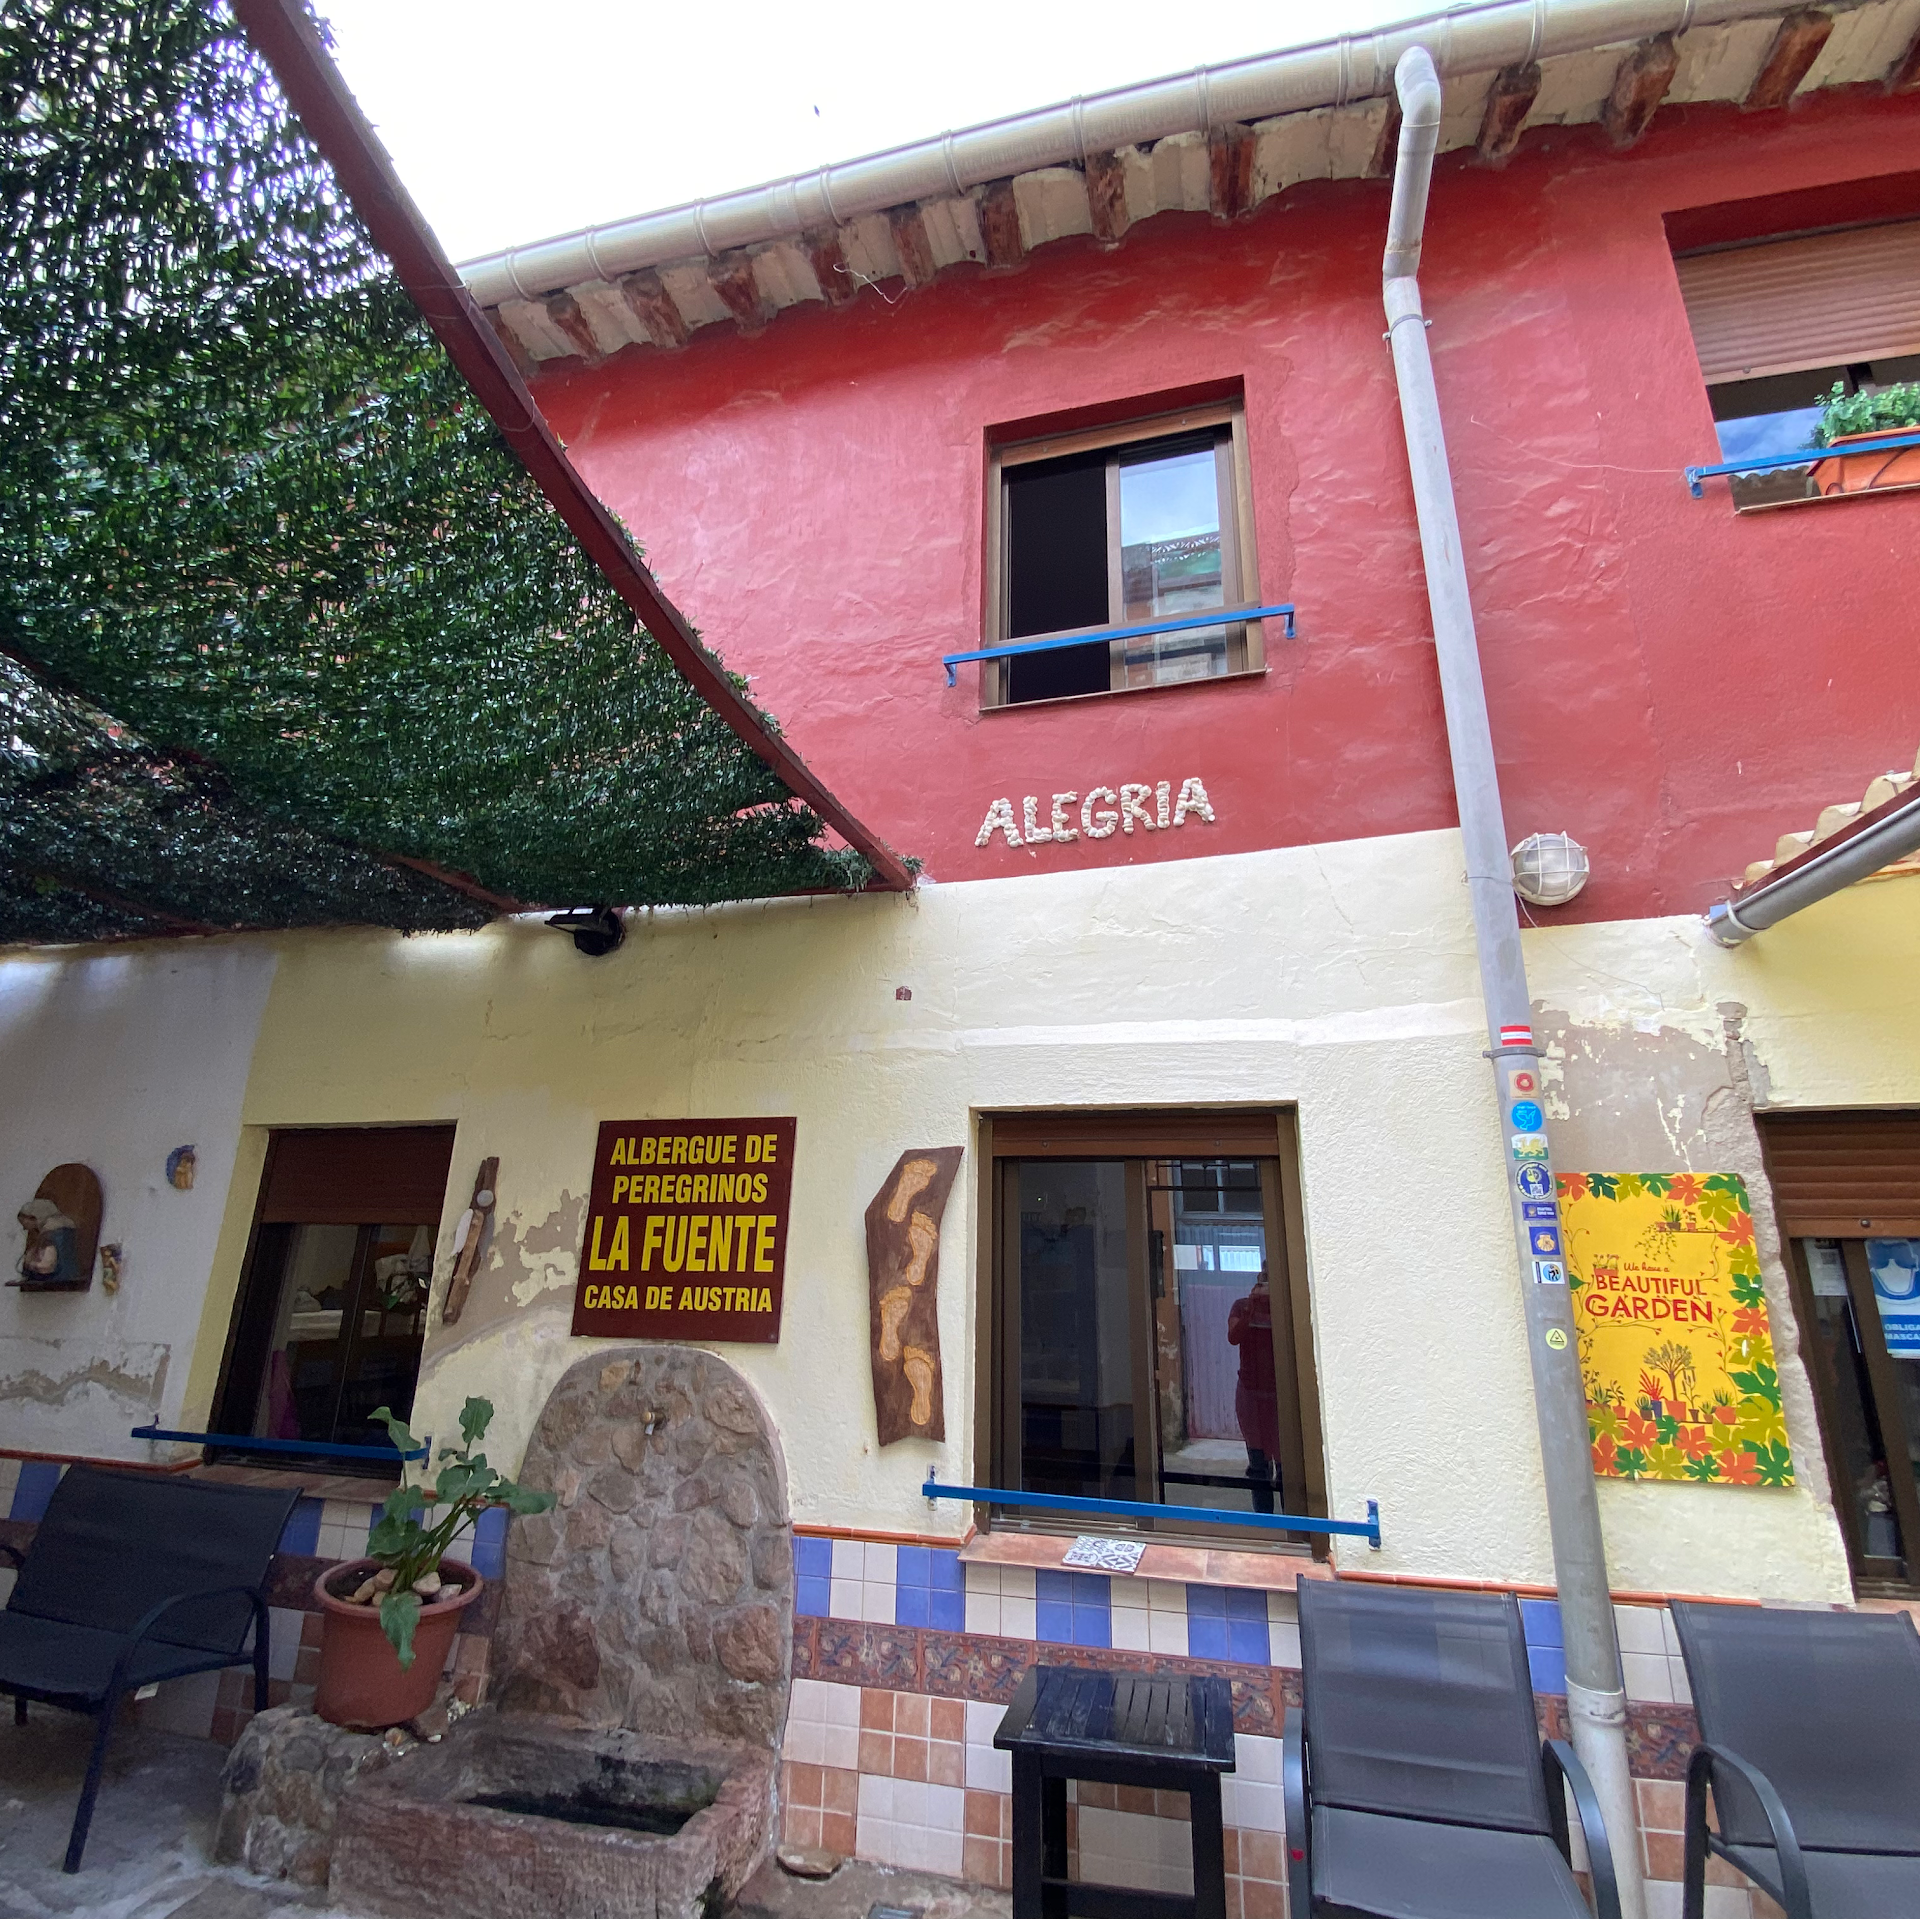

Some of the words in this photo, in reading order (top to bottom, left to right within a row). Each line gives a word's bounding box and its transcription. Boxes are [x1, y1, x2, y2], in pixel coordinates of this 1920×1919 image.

[974, 777, 1216, 847] ALEGRIA
[610, 1135, 737, 1165] ALBERGUE
[744, 1134, 778, 1163] DE
[612, 1173, 768, 1204] PEREGRINOS
[588, 1216, 629, 1271] LA
[641, 1215, 777, 1272] FUENTE
[1623, 1262, 1640, 1272] We
[1641, 1262, 1662, 1272] have
[584, 1285, 638, 1309] CASA
[645, 1286, 673, 1310] DE
[678, 1287, 772, 1312] AUSTRIA
[1596, 1274, 1707, 1296] BEAUTIFUL
[1585, 1294, 1713, 1324] GARDEN
